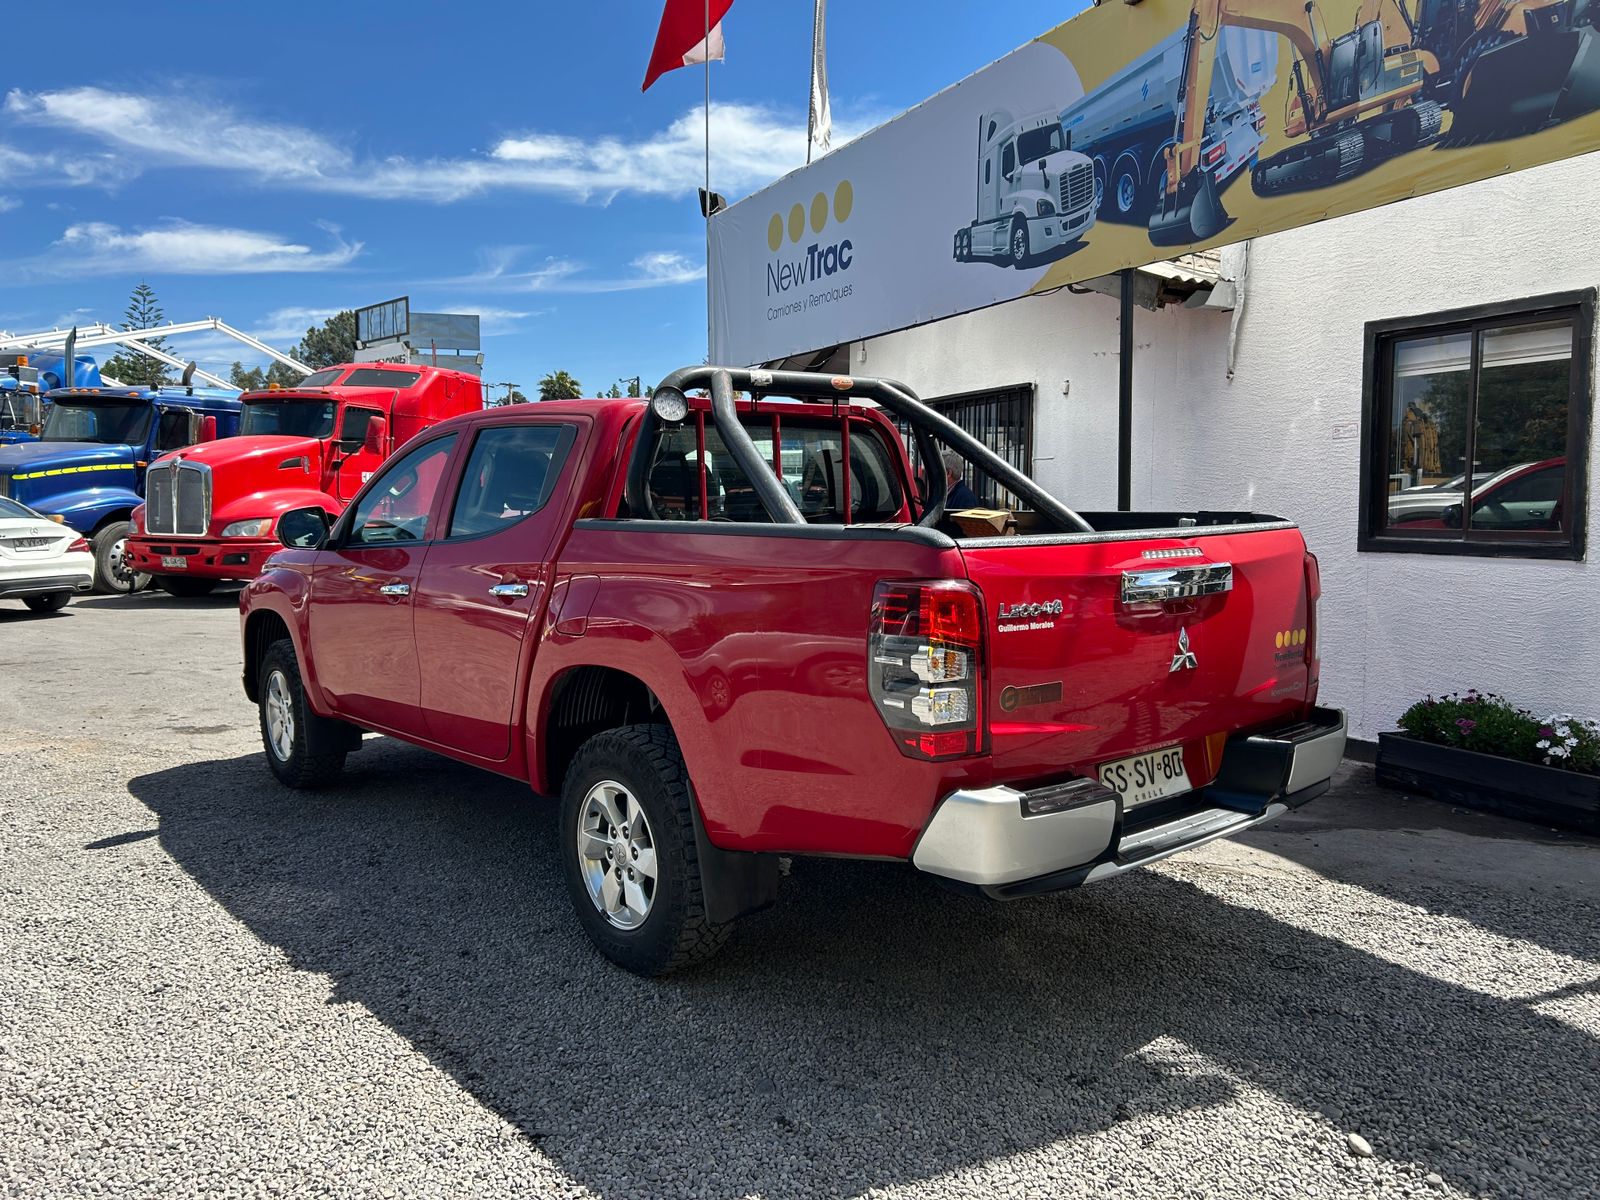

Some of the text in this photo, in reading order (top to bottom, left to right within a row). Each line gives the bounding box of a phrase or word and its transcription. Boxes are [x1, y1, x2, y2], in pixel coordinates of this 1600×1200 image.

[767, 239, 853, 297] NewTrac
[767, 283, 853, 321] Camiones y Remolques
[998, 621, 1055, 633] Guillermo Morales
[1134, 787, 1164, 802] CHILE
